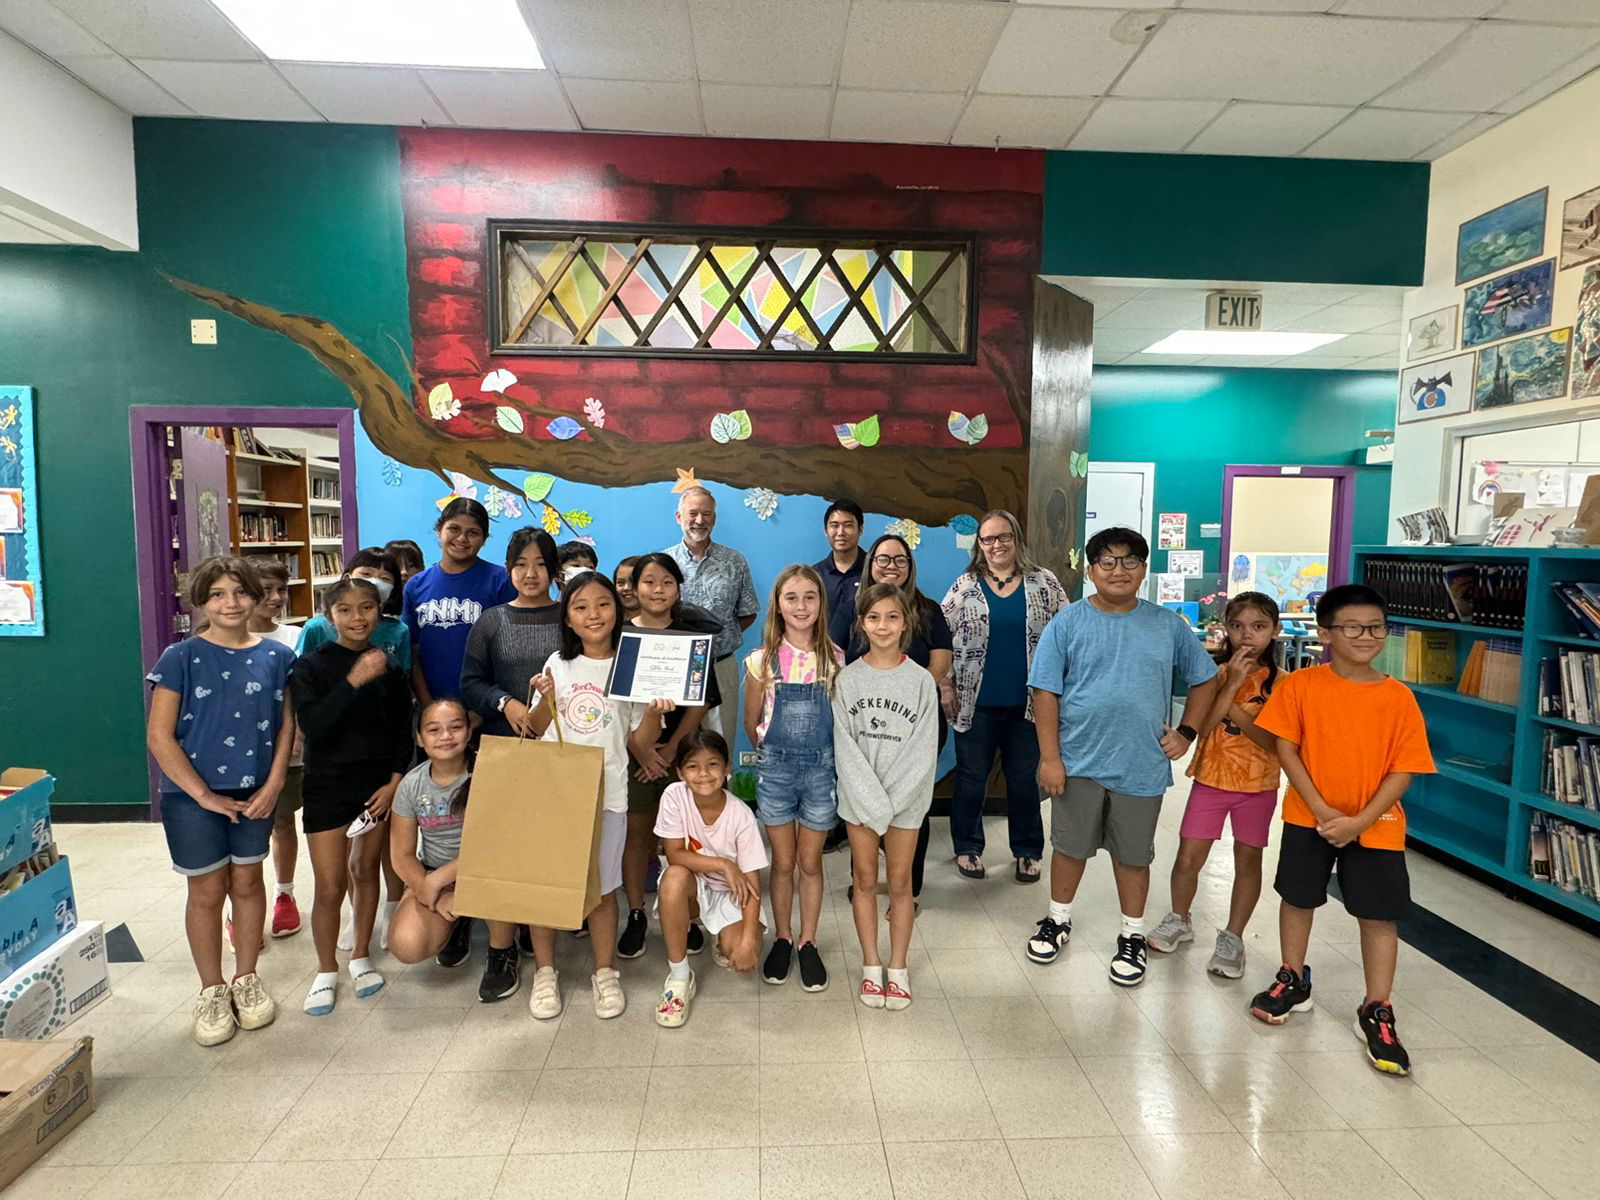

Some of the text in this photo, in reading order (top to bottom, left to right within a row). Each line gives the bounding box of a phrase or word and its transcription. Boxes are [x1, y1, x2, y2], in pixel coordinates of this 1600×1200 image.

[1218, 296, 1258, 326] EXIT
[848, 698, 918, 723] WEEKENDING
[29, 917, 38, 932] A
[79, 942, 96, 957] 250
[86, 950, 97, 961] 16
